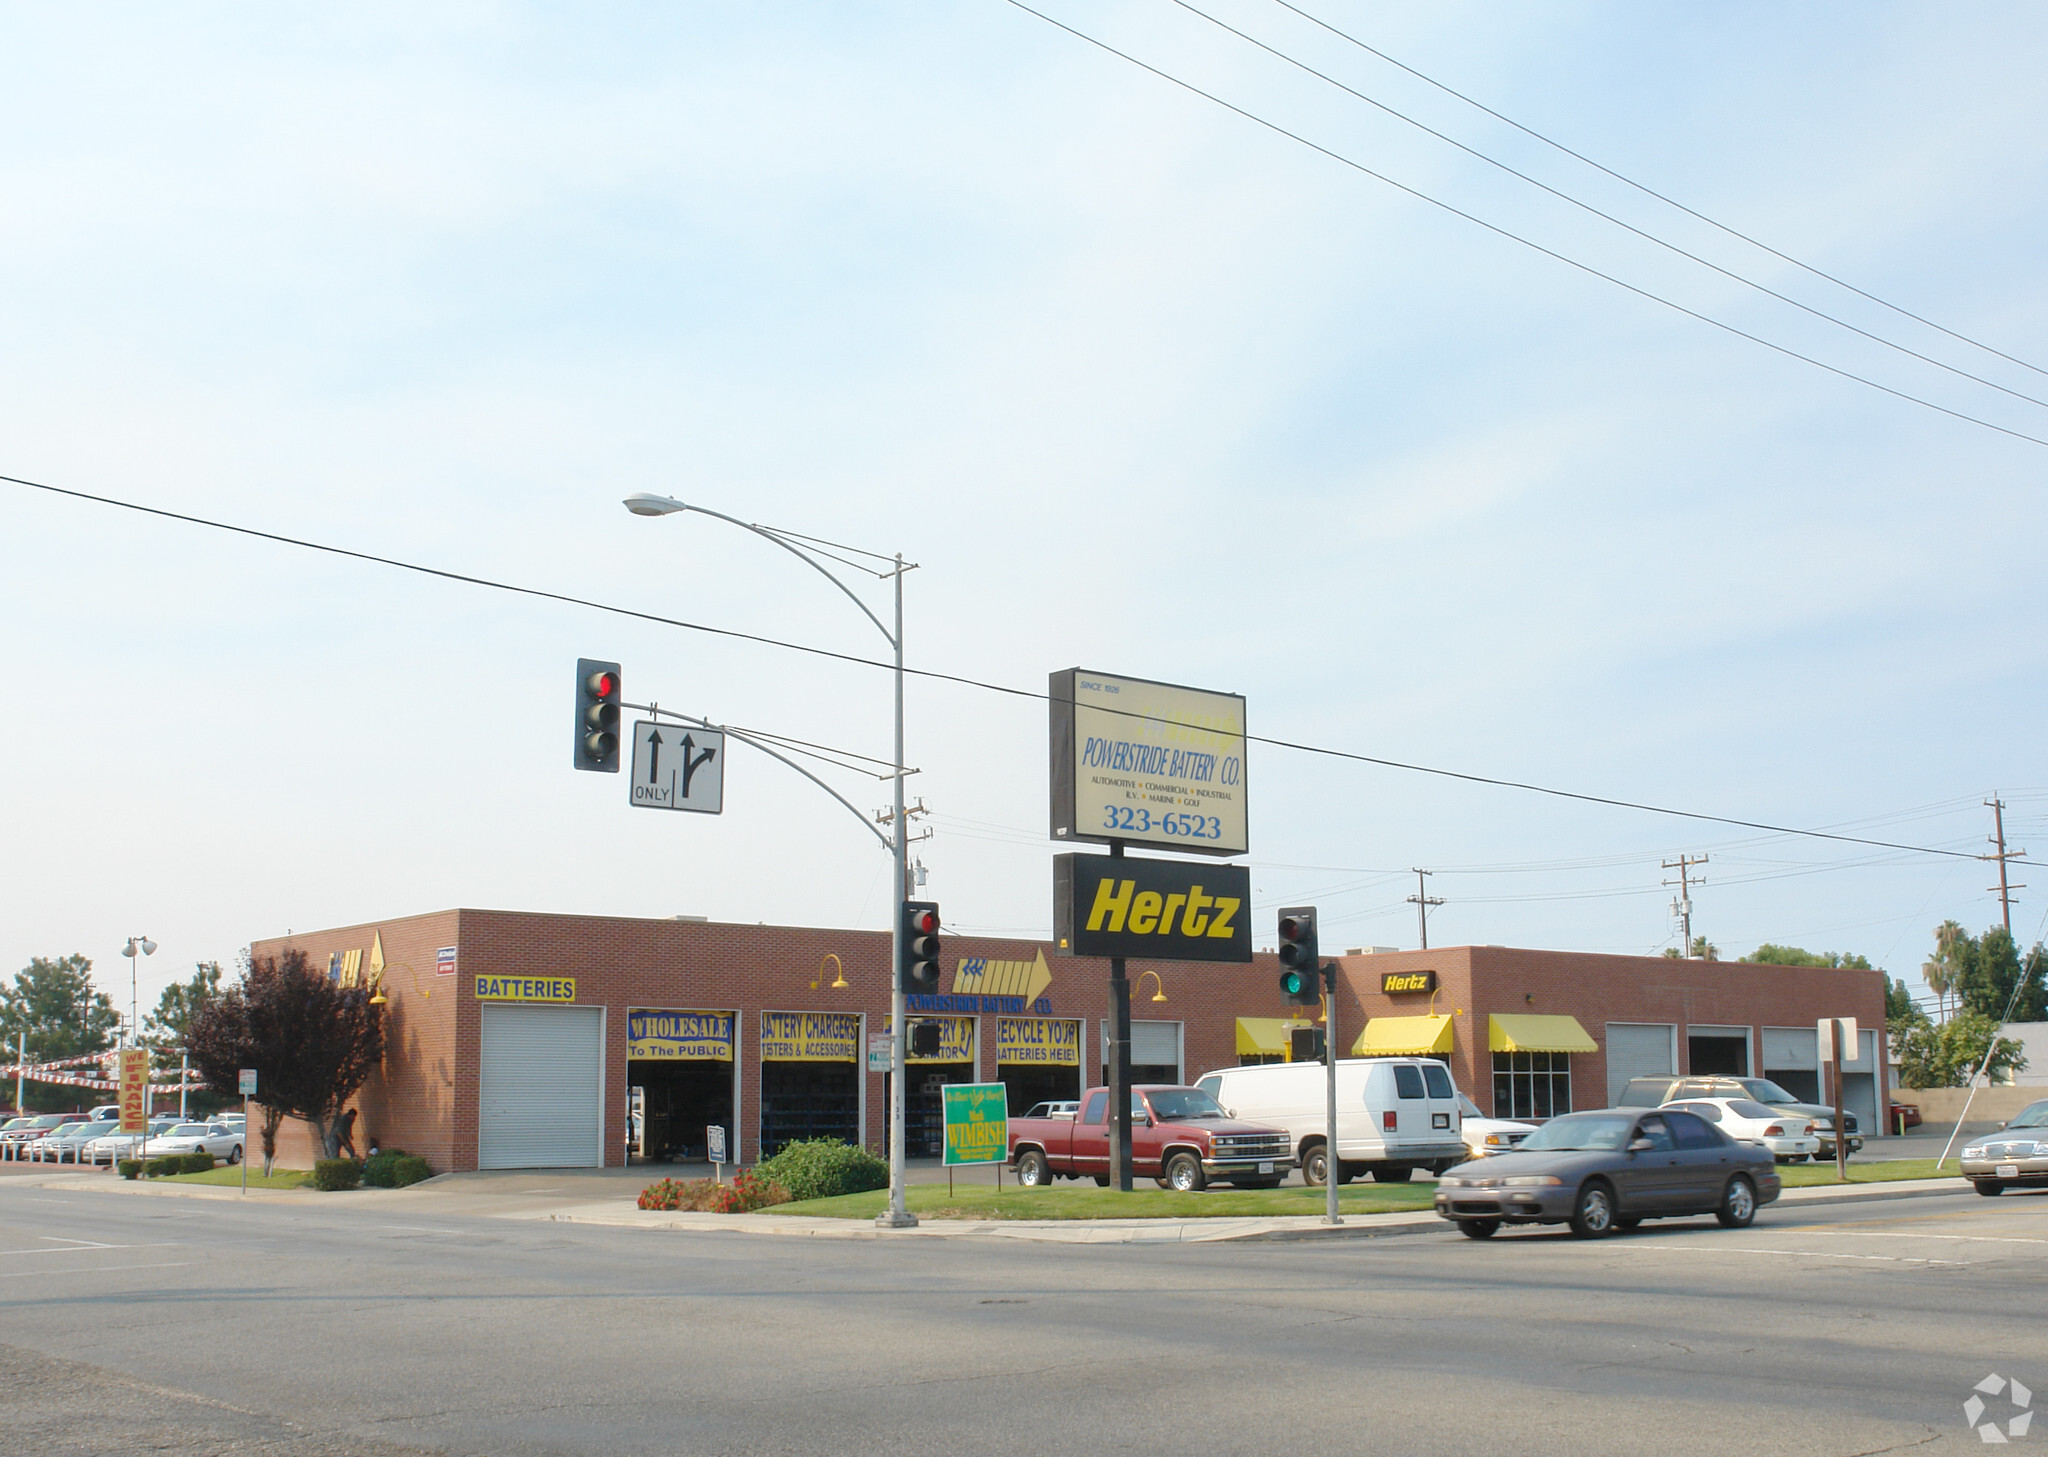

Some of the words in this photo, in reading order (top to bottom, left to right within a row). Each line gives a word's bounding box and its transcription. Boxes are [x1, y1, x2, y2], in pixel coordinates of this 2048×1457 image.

[1080, 681, 1102, 692] SINCE
[1082, 737, 1170, 776] POWERSTRIDE
[1169, 749, 1218, 783] BATTERY
[1221, 756, 1240, 786] CO.
[635, 786, 670, 801] ONLY
[1091, 775, 1136, 789] AUTOMOTIVE
[1145, 782, 1188, 795] COMMERCIAL
[1196, 789, 1232, 801] INDUSTRIAL
[1149, 794, 1175, 805] MARINE
[1183, 798, 1201, 808] GOLF
[1103, 805, 1221, 840] 323-6523
[1085, 878, 1241, 939] Hertz
[477, 978, 573, 999] BATTERIES
[1385, 974, 1428, 991] Hertz
[906, 993, 979, 1012] POWERSTRIDE
[982, 996, 1024, 1013] BATTERY
[630, 1017, 728, 1039] WHOLESALE
[806, 1014, 856, 1040] CHARGERS
[126, 1051, 144, 1063] WE
[630, 1046, 645, 1056] To
[649, 1046, 674, 1057] The
[679, 1046, 726, 1057] PUBLIC
[796, 1043, 802, 1057] &
[125, 1064, 144, 1130] FINANCE
[947, 1121, 1006, 1148] WIMBISH
